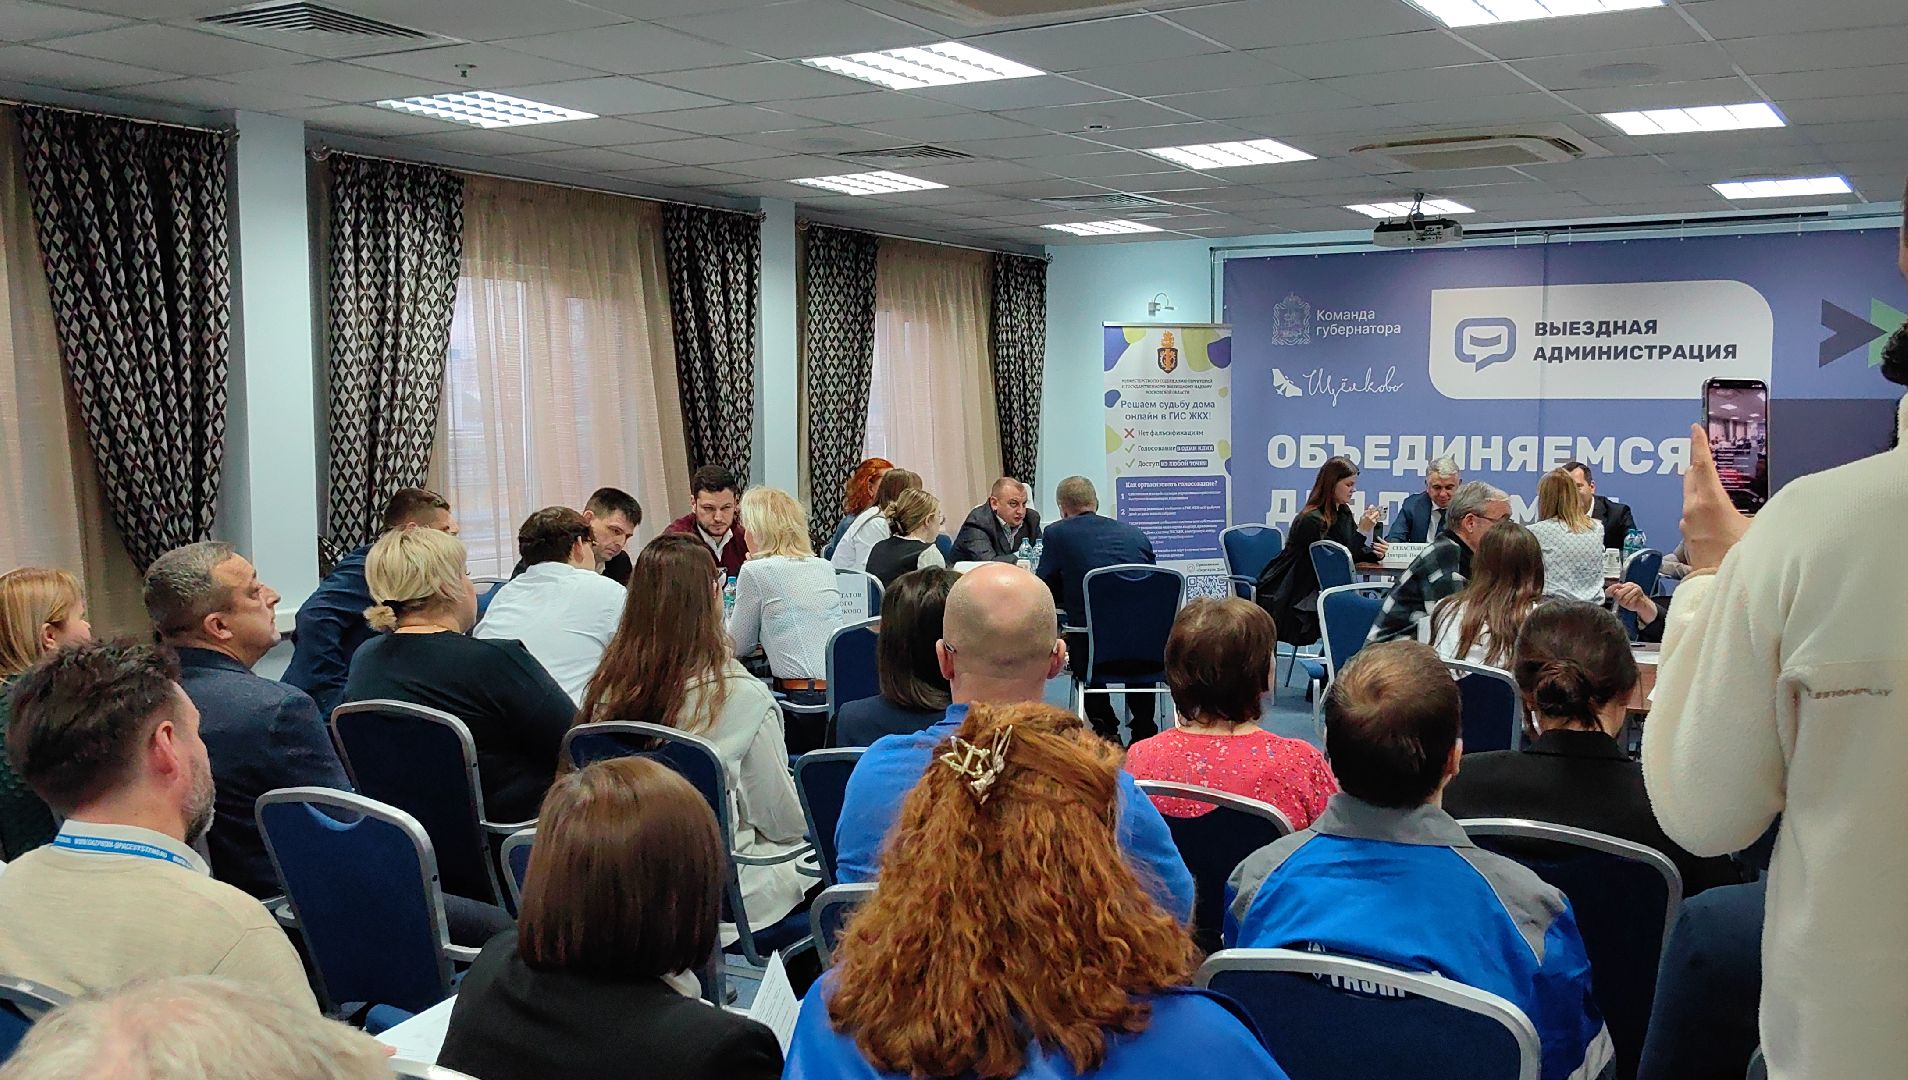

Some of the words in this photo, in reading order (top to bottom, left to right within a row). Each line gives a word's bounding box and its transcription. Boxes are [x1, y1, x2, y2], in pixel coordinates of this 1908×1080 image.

[1316, 309, 1375, 322] Команда
[1316, 324, 1401, 338] губернатора
[1534, 319, 1658, 338] ВЫЕЗДНАЯ
[1533, 344, 1738, 363] АДМИНИСТРАЦИЯ
[1120, 400, 1157, 409] Решаем
[1159, 400, 1191, 410] судьбу
[1192, 401, 1216, 409] дома
[1125, 411, 1158, 420] онлайн
[1168, 412, 1187, 420] ГИС
[1189, 411, 1211, 420] ЖКХ!
[1267, 434, 1691, 477] ОБЪЕДИНЯЕМСЯ
[1138, 460, 1160, 468] Доступ
